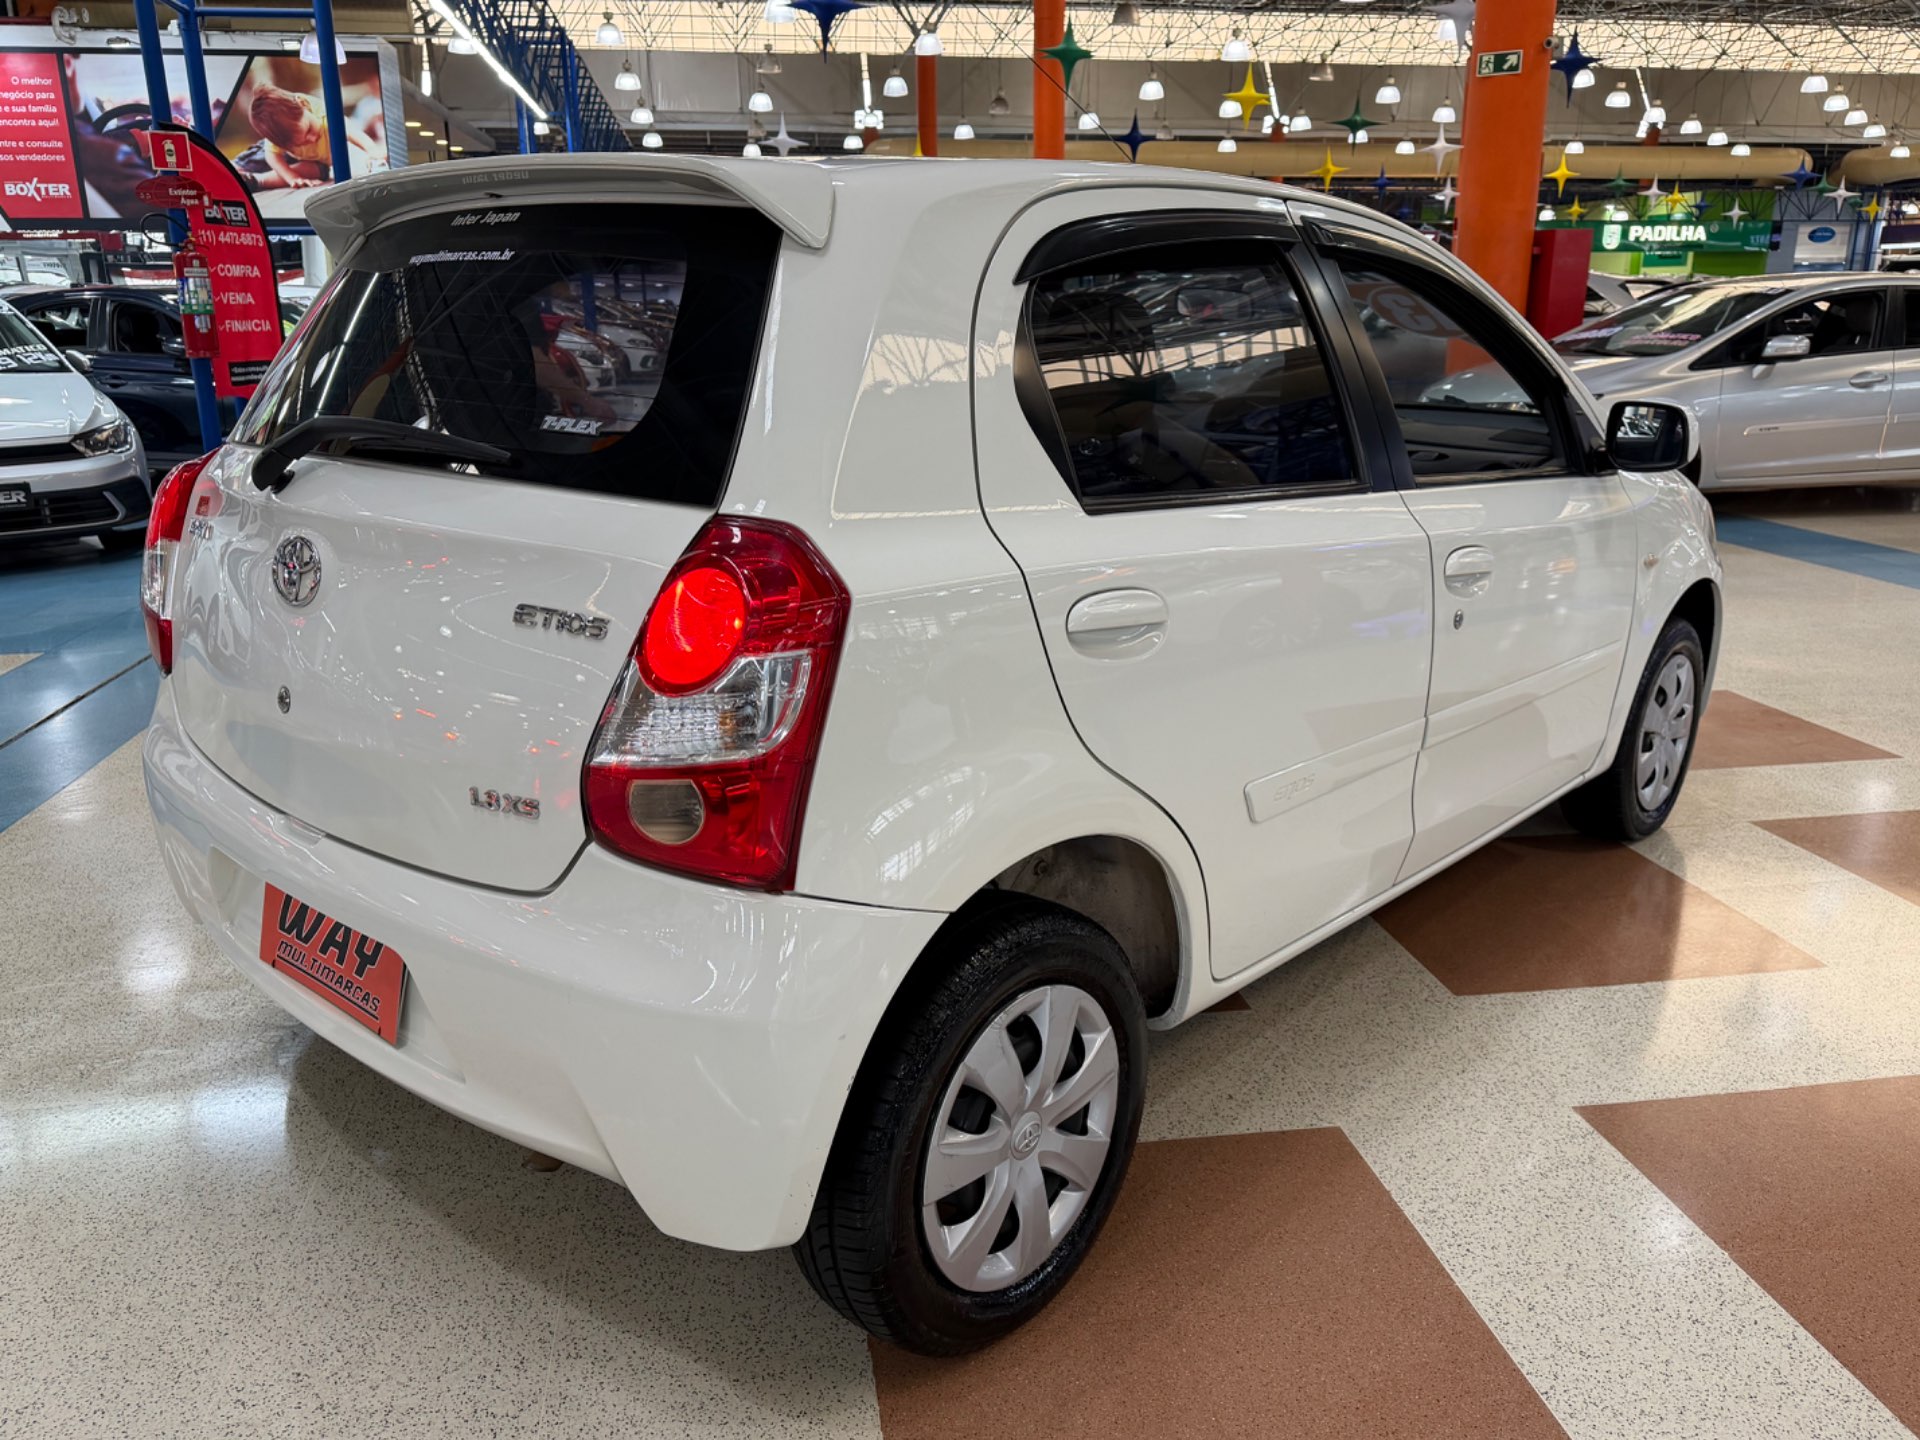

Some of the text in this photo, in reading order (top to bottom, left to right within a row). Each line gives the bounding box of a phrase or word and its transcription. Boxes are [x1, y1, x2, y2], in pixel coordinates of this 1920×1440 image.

[11, 76, 52, 86] O melhor
[35, 92, 55, 101] para
[28, 104, 57, 113] família
[15, 153, 65, 161] vendedores
[4, 177, 71, 202] BOXTER
[479, 210, 521, 226] Japan
[1628, 225, 1707, 242] PADILHA
[217, 263, 261, 278] COMPRA
[225, 319, 272, 333] FINANCIA
[512, 603, 610, 641] ETIOS
[278, 893, 384, 980] WAY
[277, 940, 381, 1013] MULTIMARCAS
